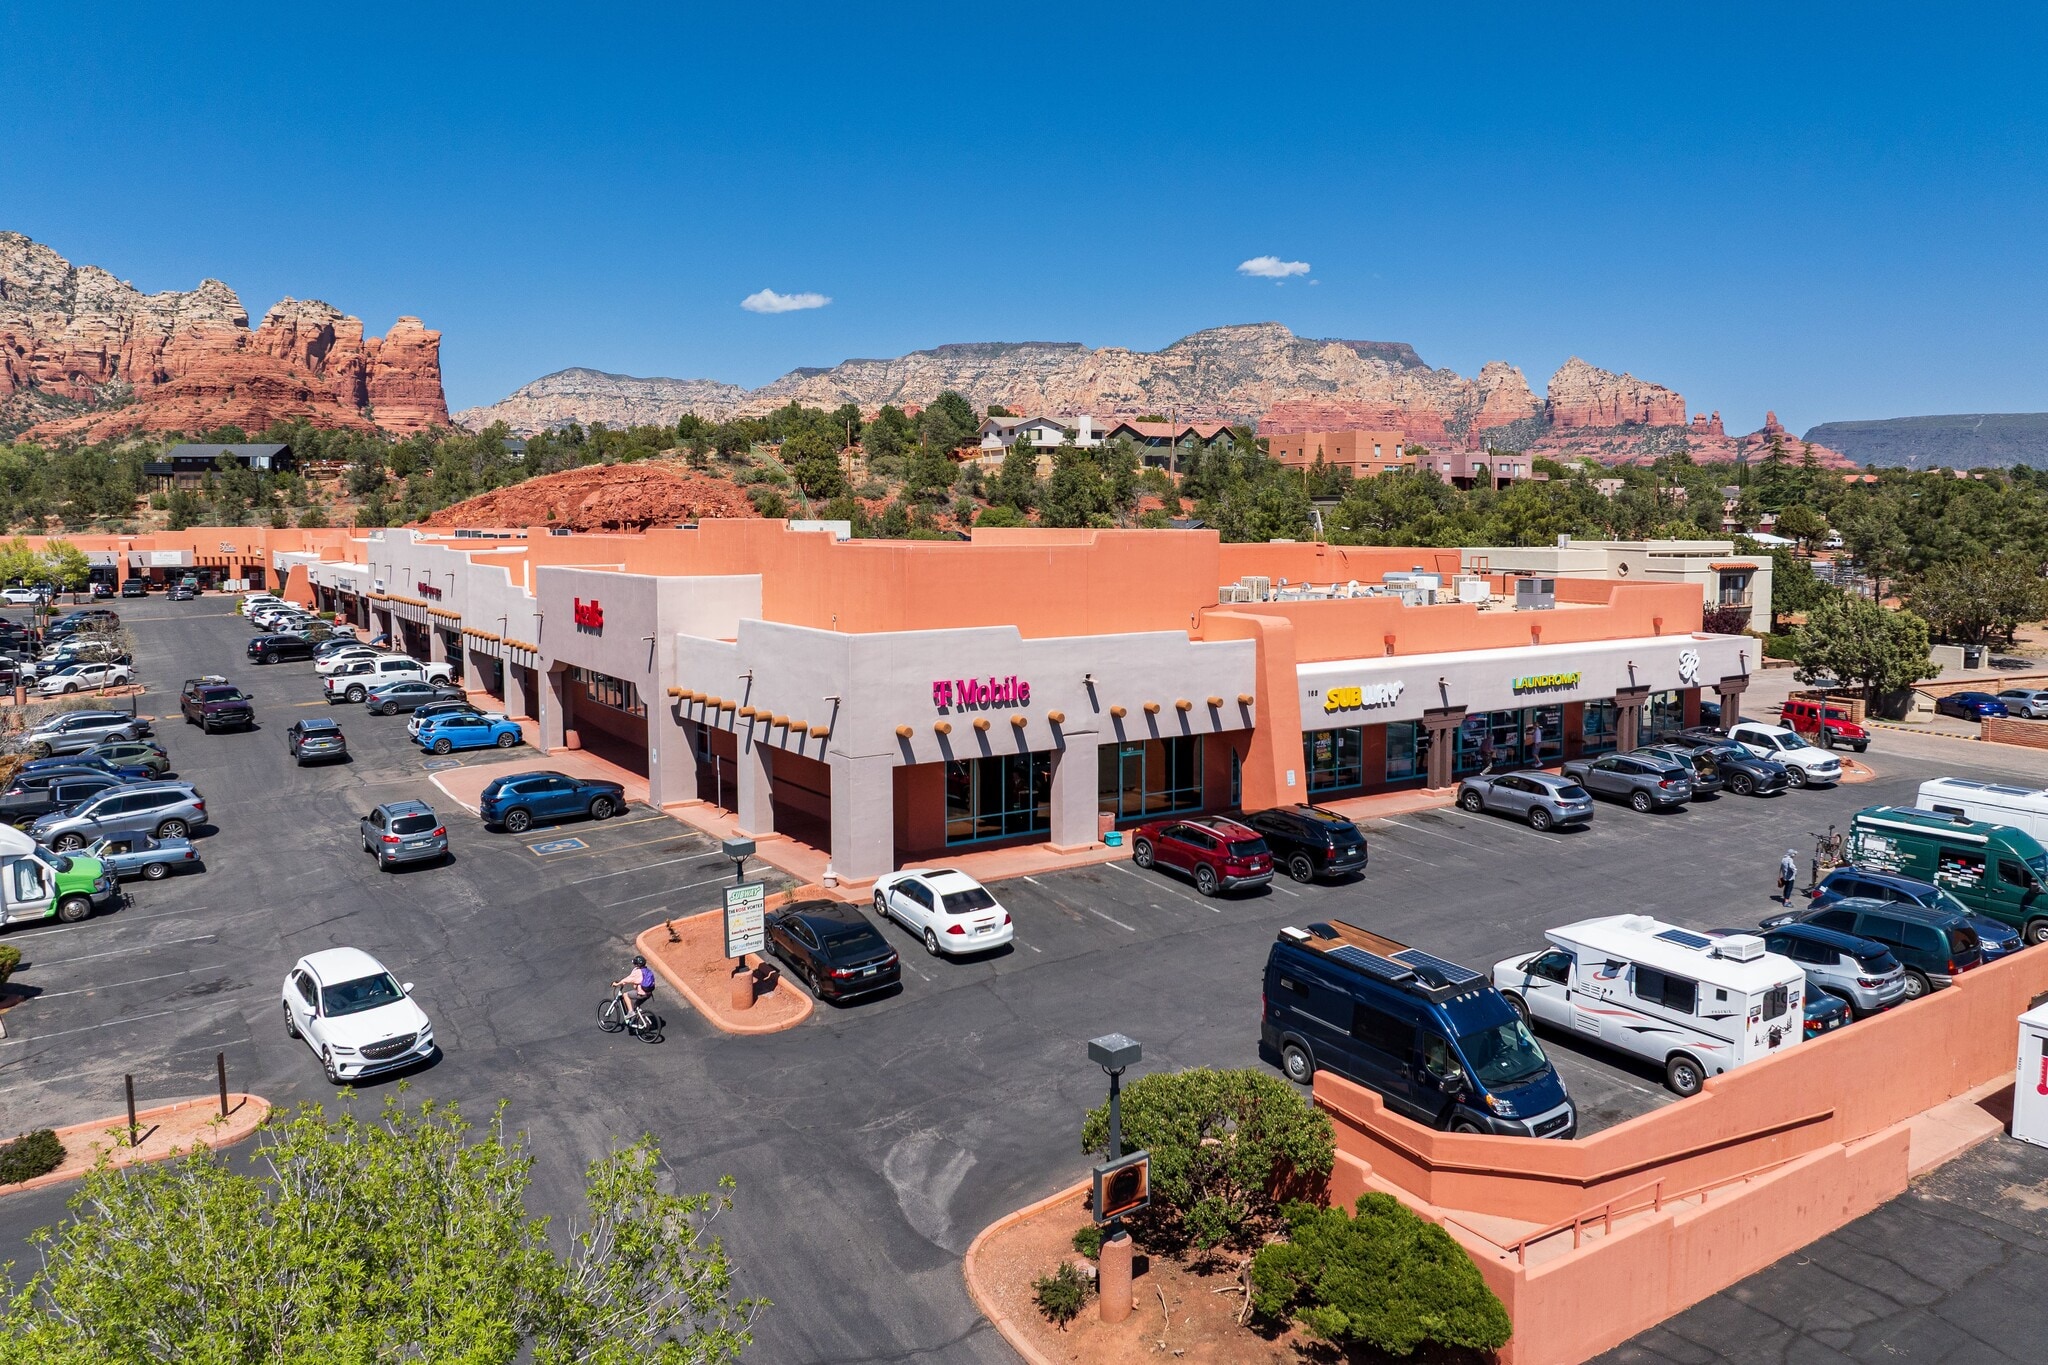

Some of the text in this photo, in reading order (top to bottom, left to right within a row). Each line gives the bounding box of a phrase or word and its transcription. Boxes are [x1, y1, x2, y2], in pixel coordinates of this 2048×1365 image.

[956, 674, 1030, 705] Mobile
[1513, 672, 1582, 689] LAUNDROMAT
[1323, 680, 1404, 711] SUBWAY
[729, 886, 761, 902] SUBWAY
